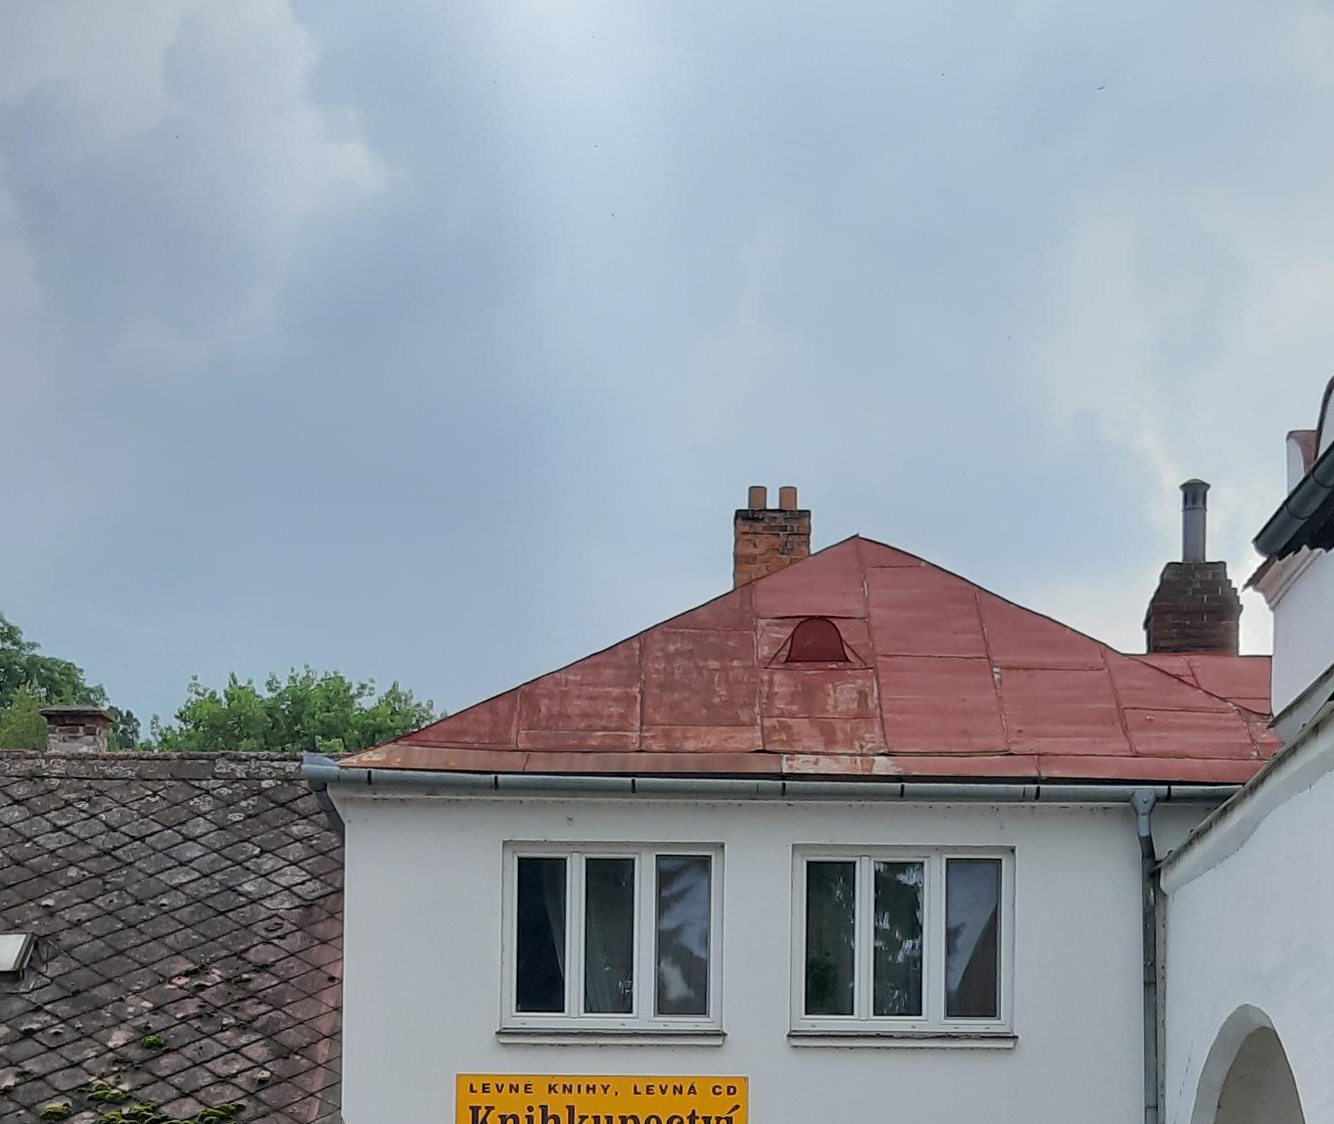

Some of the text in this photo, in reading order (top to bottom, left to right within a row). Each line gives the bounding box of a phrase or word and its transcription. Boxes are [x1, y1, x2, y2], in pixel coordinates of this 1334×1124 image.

[547, 1083, 619, 1097] KNIHY,
[633, 1082, 698, 1096] LEVNÁ
[711, 1084, 738, 1096] CD
